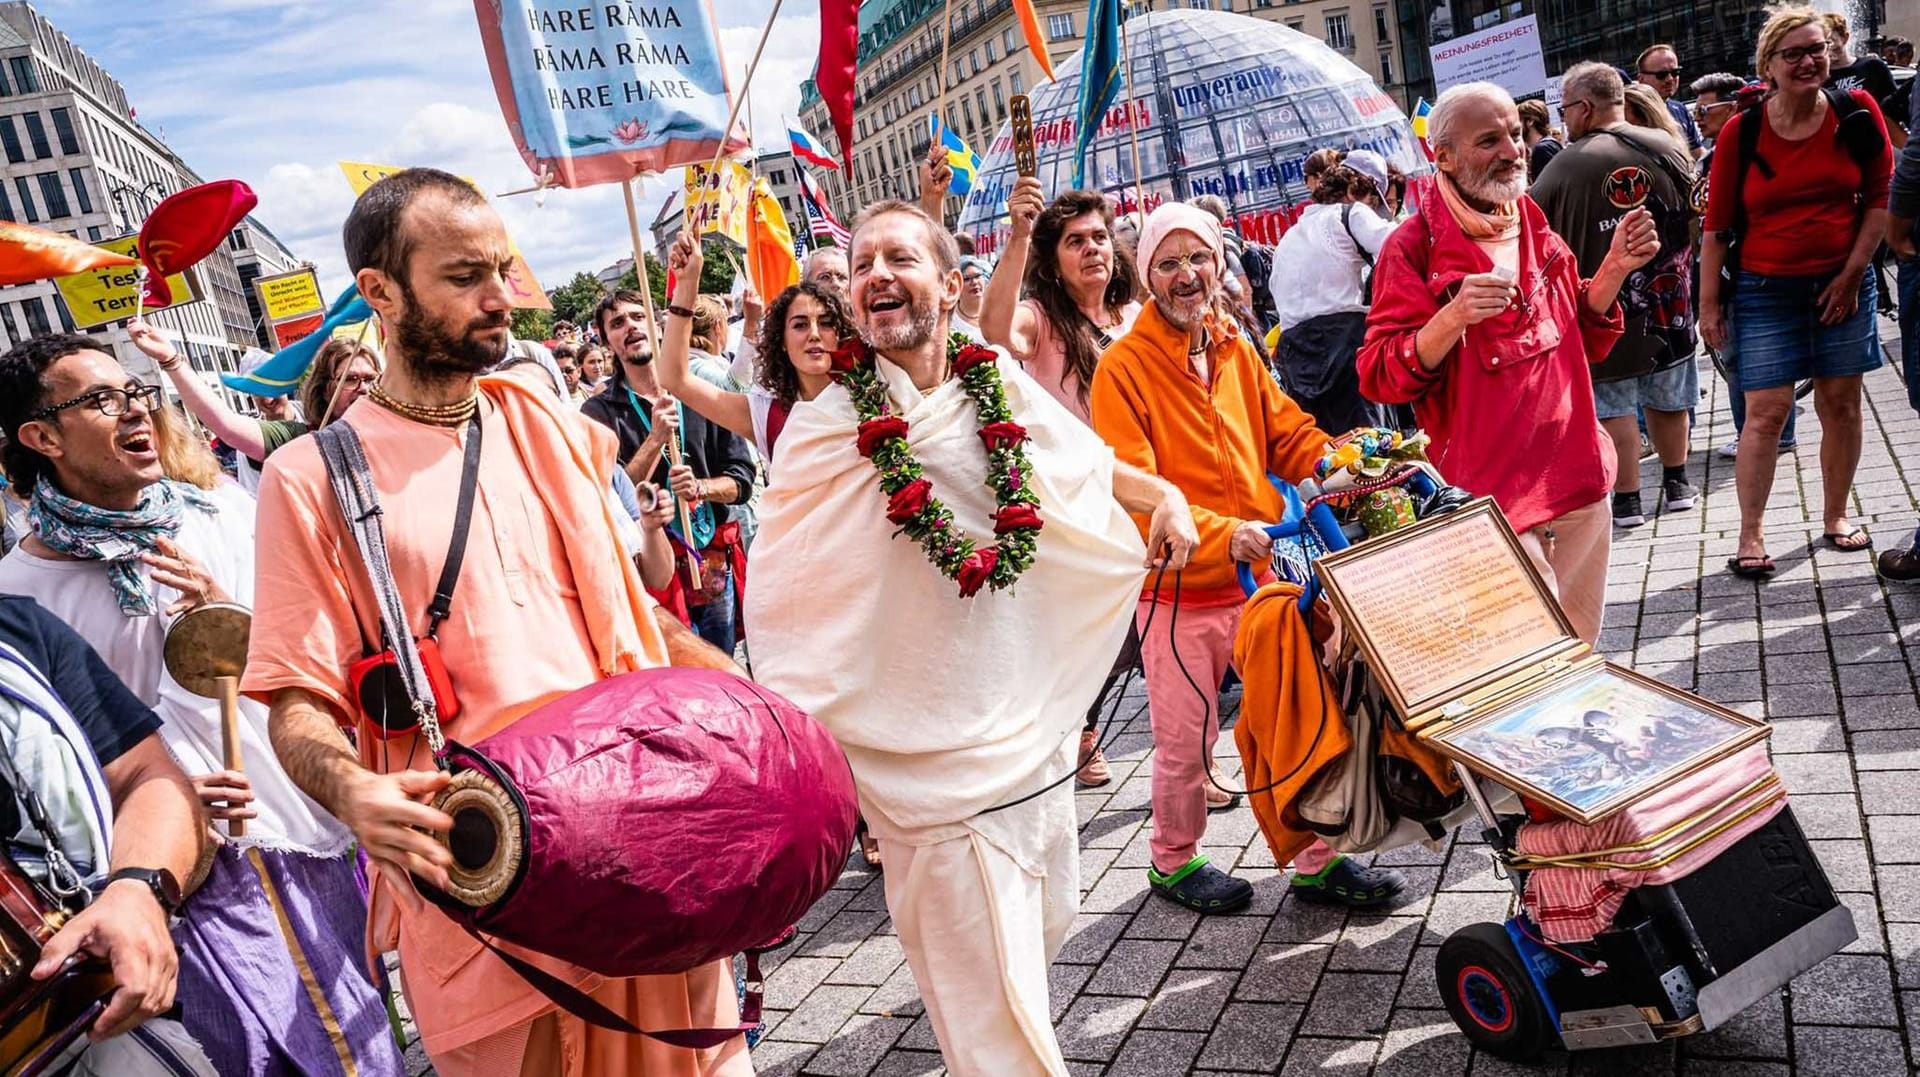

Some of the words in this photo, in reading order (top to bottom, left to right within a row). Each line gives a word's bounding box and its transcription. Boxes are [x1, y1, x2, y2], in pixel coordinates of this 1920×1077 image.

[528, 7, 595, 33] HARE
[533, 44, 606, 72] RĀMA
[616, 38, 691, 66] RĀMA
[1434, 23, 1534, 62] MEINUNGSFREIHEIT
[548, 84, 614, 111] HARE
[624, 79, 695, 103] HARE
[93, 294, 140, 313] Terr
